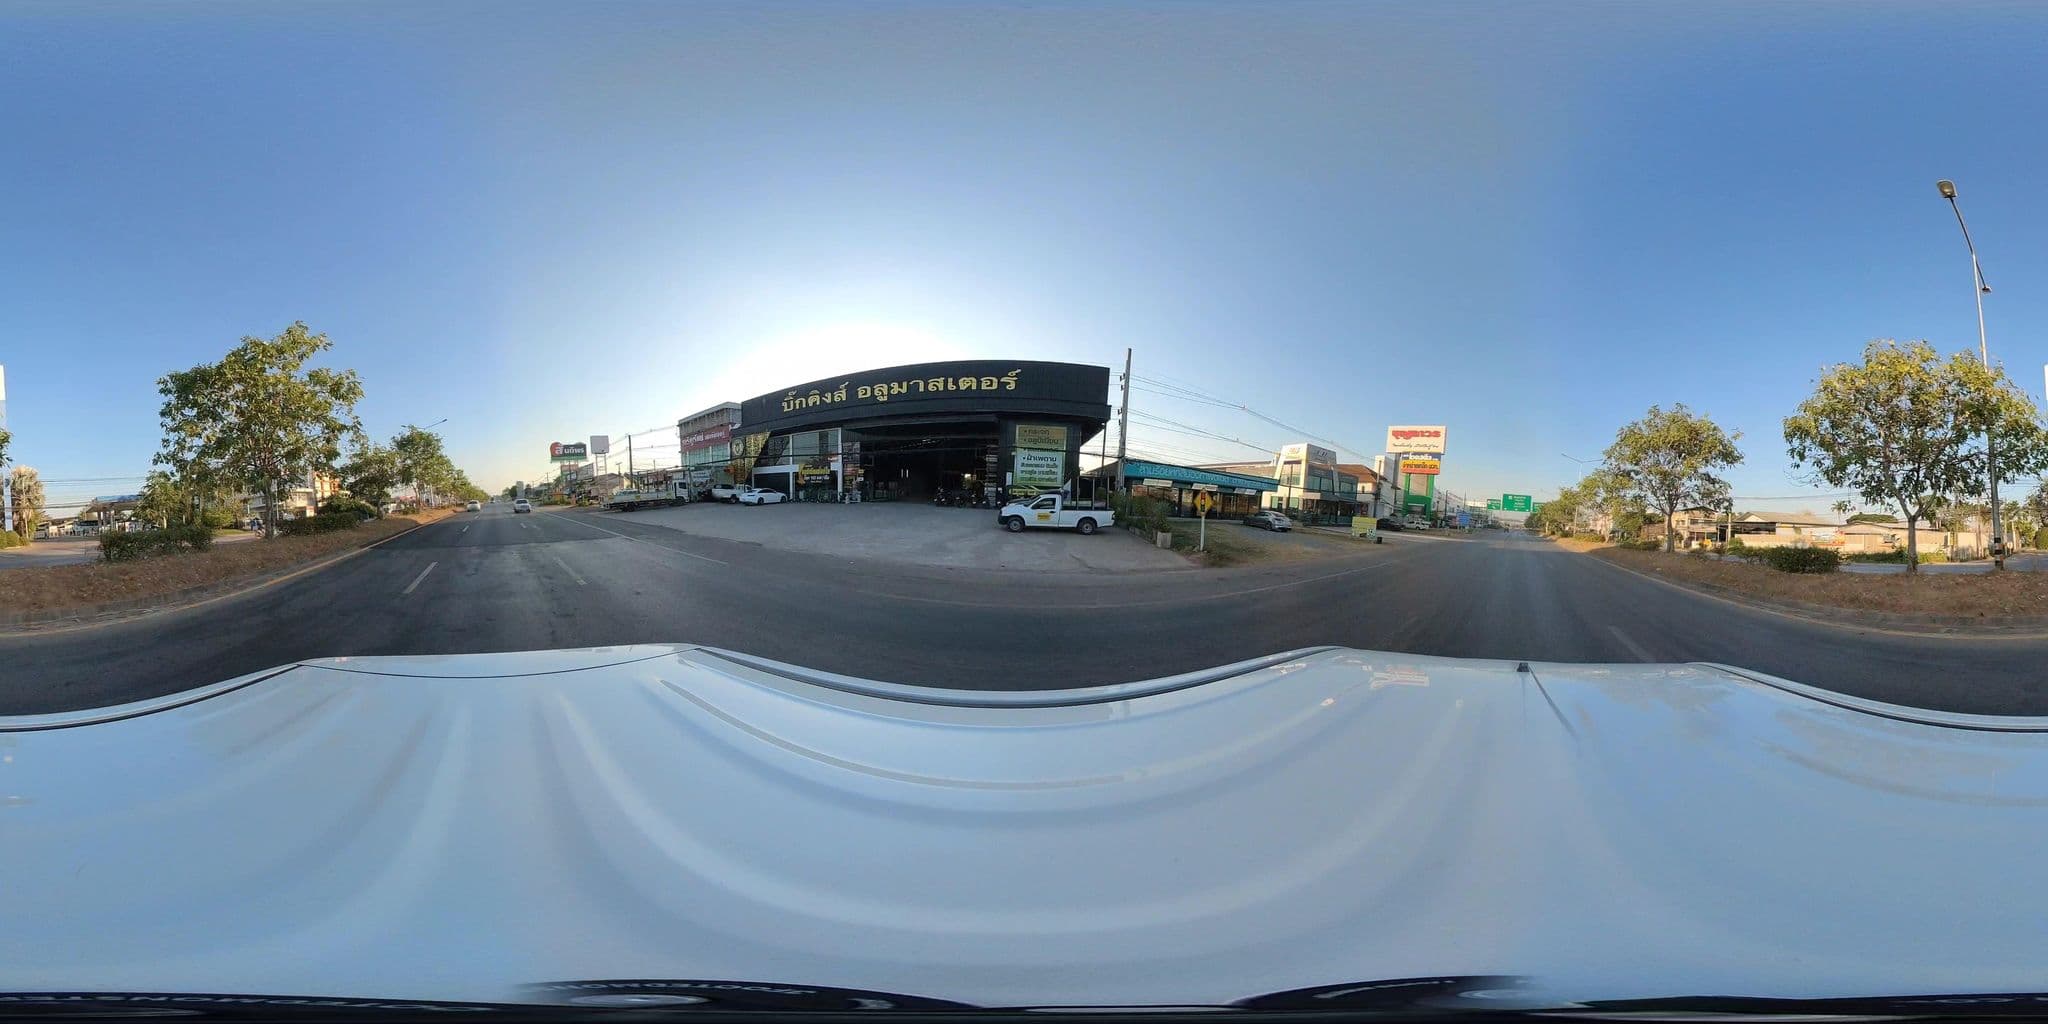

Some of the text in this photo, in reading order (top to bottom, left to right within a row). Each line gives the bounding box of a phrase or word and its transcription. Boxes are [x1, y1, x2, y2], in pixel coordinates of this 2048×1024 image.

[782, 369, 1022, 412] บิ๊กคิงส์ อลูมาสเตอร์
